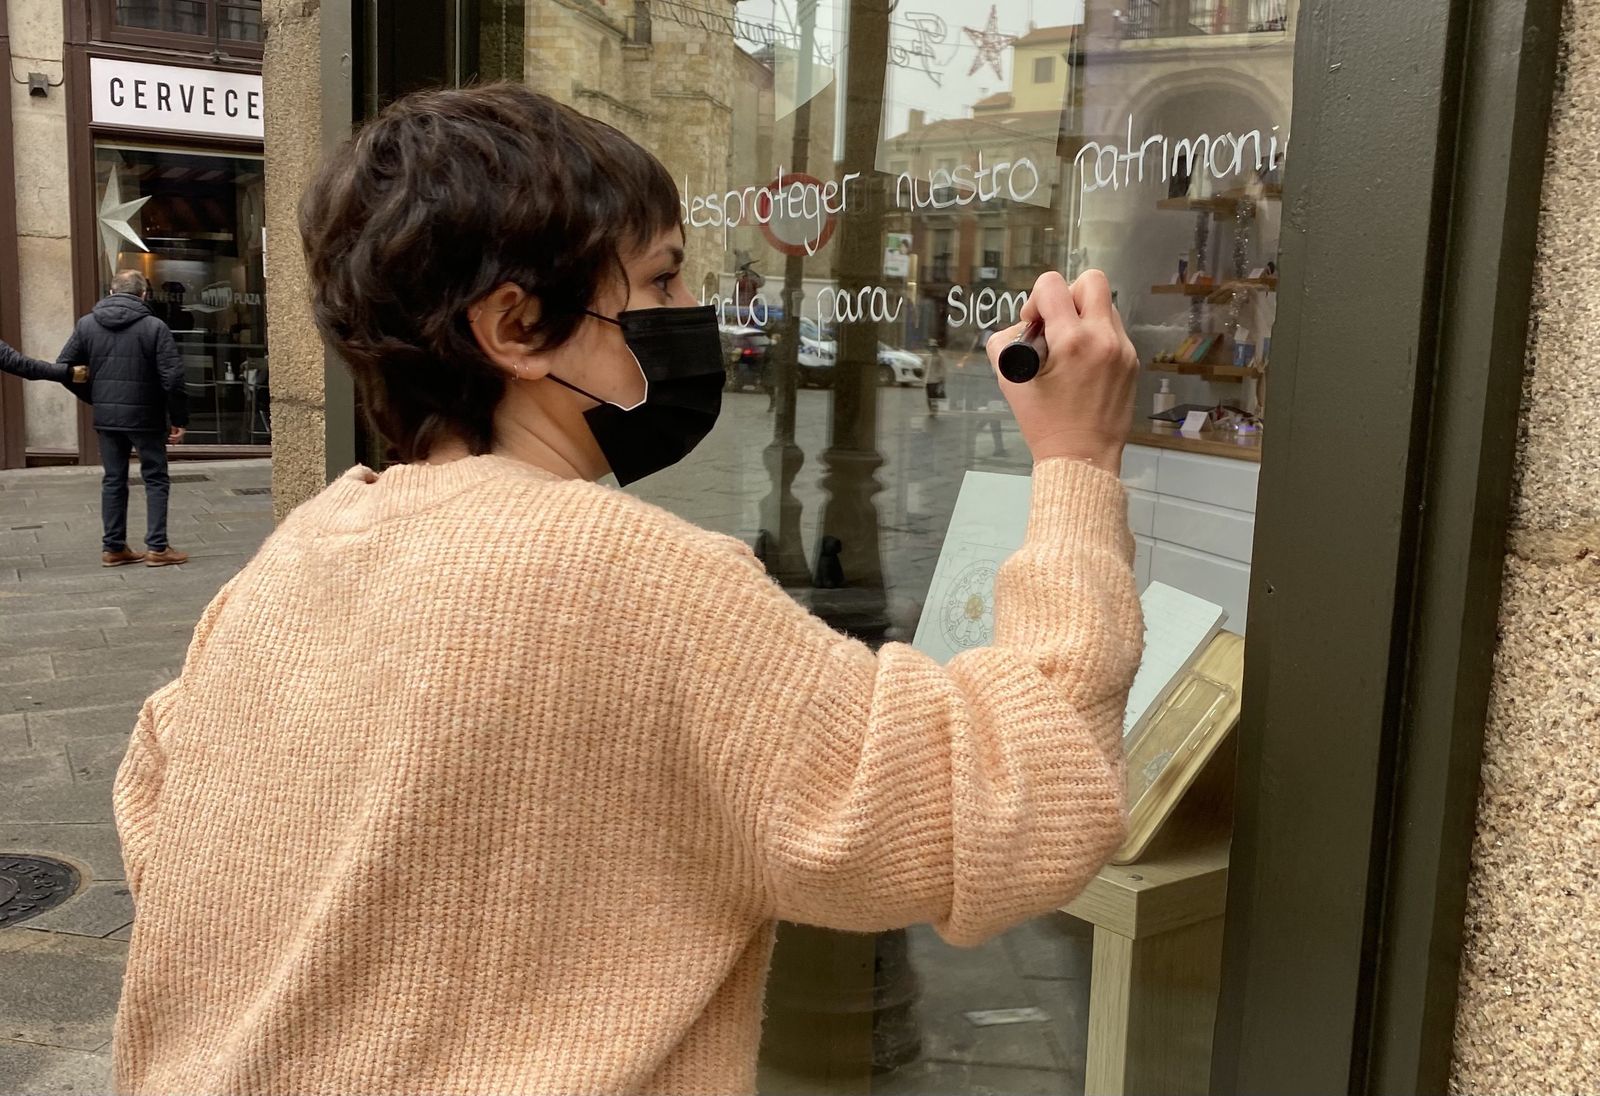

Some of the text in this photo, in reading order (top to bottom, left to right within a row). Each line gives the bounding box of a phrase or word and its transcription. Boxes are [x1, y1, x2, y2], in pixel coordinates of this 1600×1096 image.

[109, 76, 260, 120] CERVECE
[679, 164, 861, 257] desproteger
[895, 149, 1039, 212] nuestro
[233, 292, 261, 305] PLAZA
[816, 285, 903, 359] para
